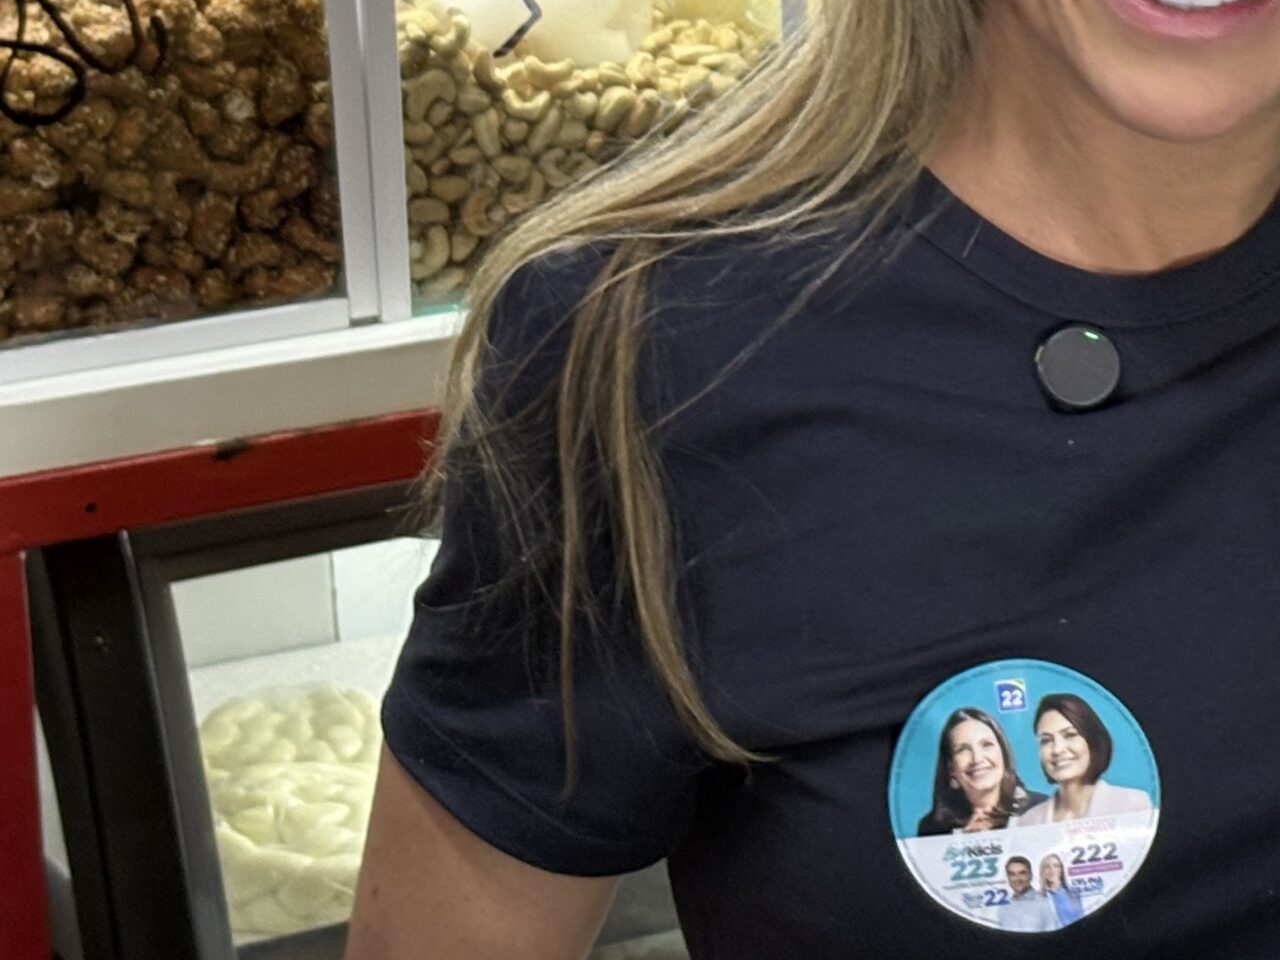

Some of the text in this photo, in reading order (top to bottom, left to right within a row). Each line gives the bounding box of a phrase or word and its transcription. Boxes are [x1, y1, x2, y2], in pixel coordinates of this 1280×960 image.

[1001, 690, 1023, 708] 22
[1071, 842, 1118, 865] 222
[951, 857, 998, 881] 223
[984, 889, 1010, 907] 22
